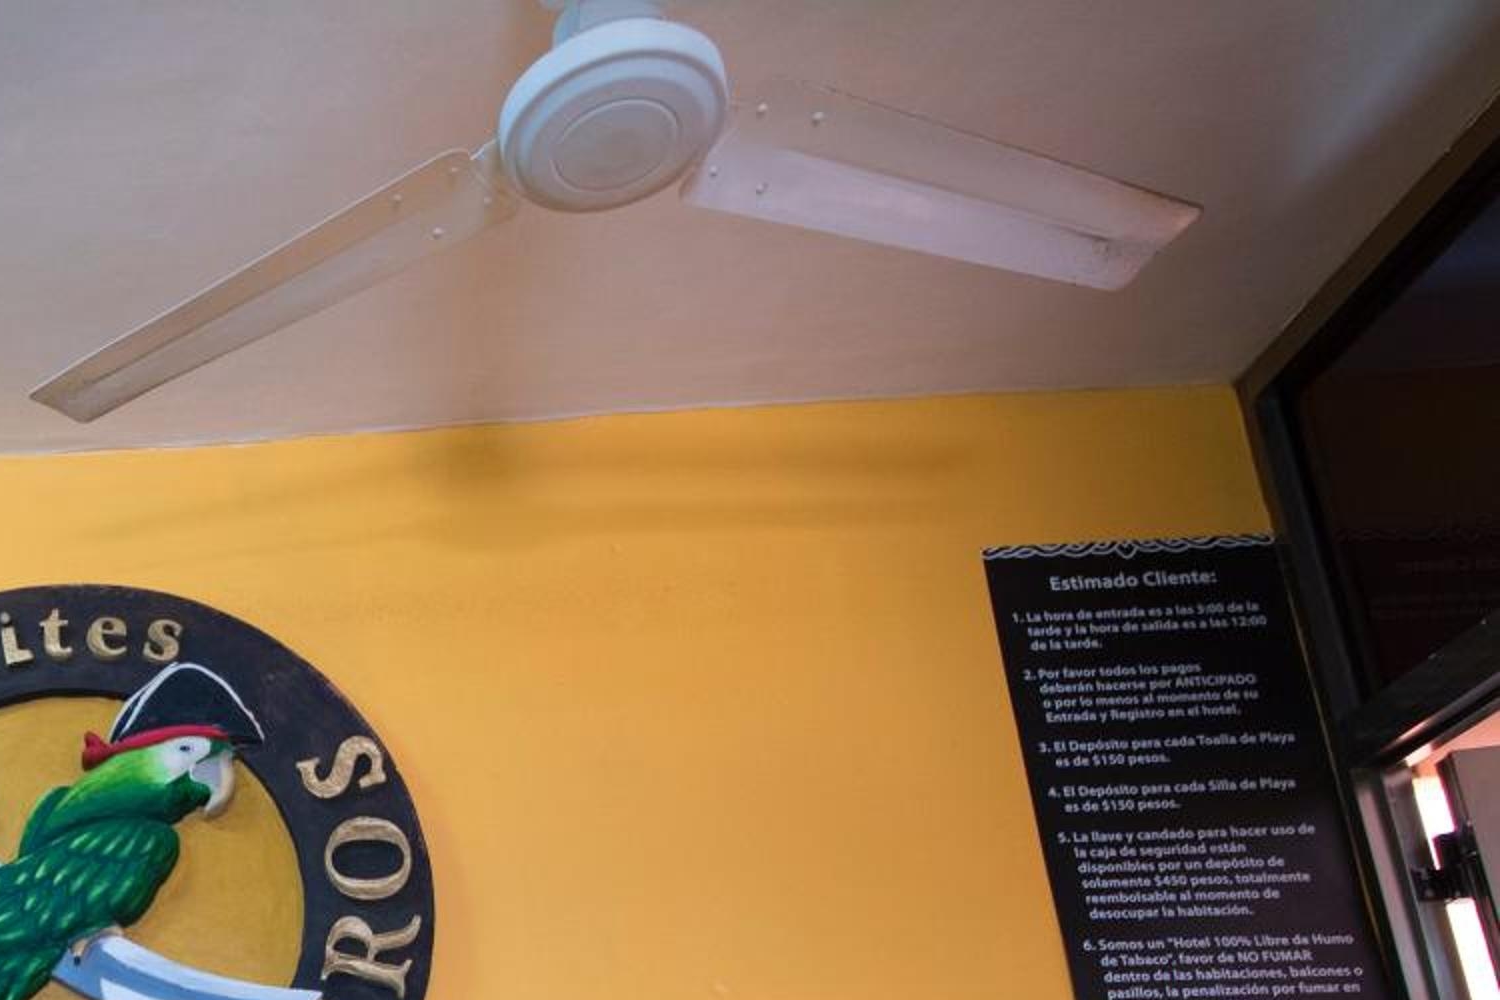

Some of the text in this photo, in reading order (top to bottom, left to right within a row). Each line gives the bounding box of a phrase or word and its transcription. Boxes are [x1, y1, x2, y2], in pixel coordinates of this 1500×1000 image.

[1049, 571, 1217, 592] Estimado Cliente:
[1062, 785, 1076, 797] El
[1077, 784, 1139, 801] Depósito
[1140, 784, 1172, 797] para
[1173, 780, 1207, 793] cada
[1239, 778, 1257, 791] de
[1064, 803, 1080, 812] es
[1081, 800, 1099, 812] de
[1137, 799, 1180, 812] pesos.
[1089, 904, 1254, 921] desocupar la habitación.
[1097, 938, 1145, 951] Somos
[1146, 940, 1165, 949] un
[1166, 936, 1211, 949] "Hotel
[1213, 935, 1253, 947] 100%
[1253, 934, 1290, 947] Libre
[1291, 934, 1310, 945] de
[1311, 933, 1355, 945] Humo
[1100, 949, 1313, 966] de Tabaco", favor de NO FUMAR
